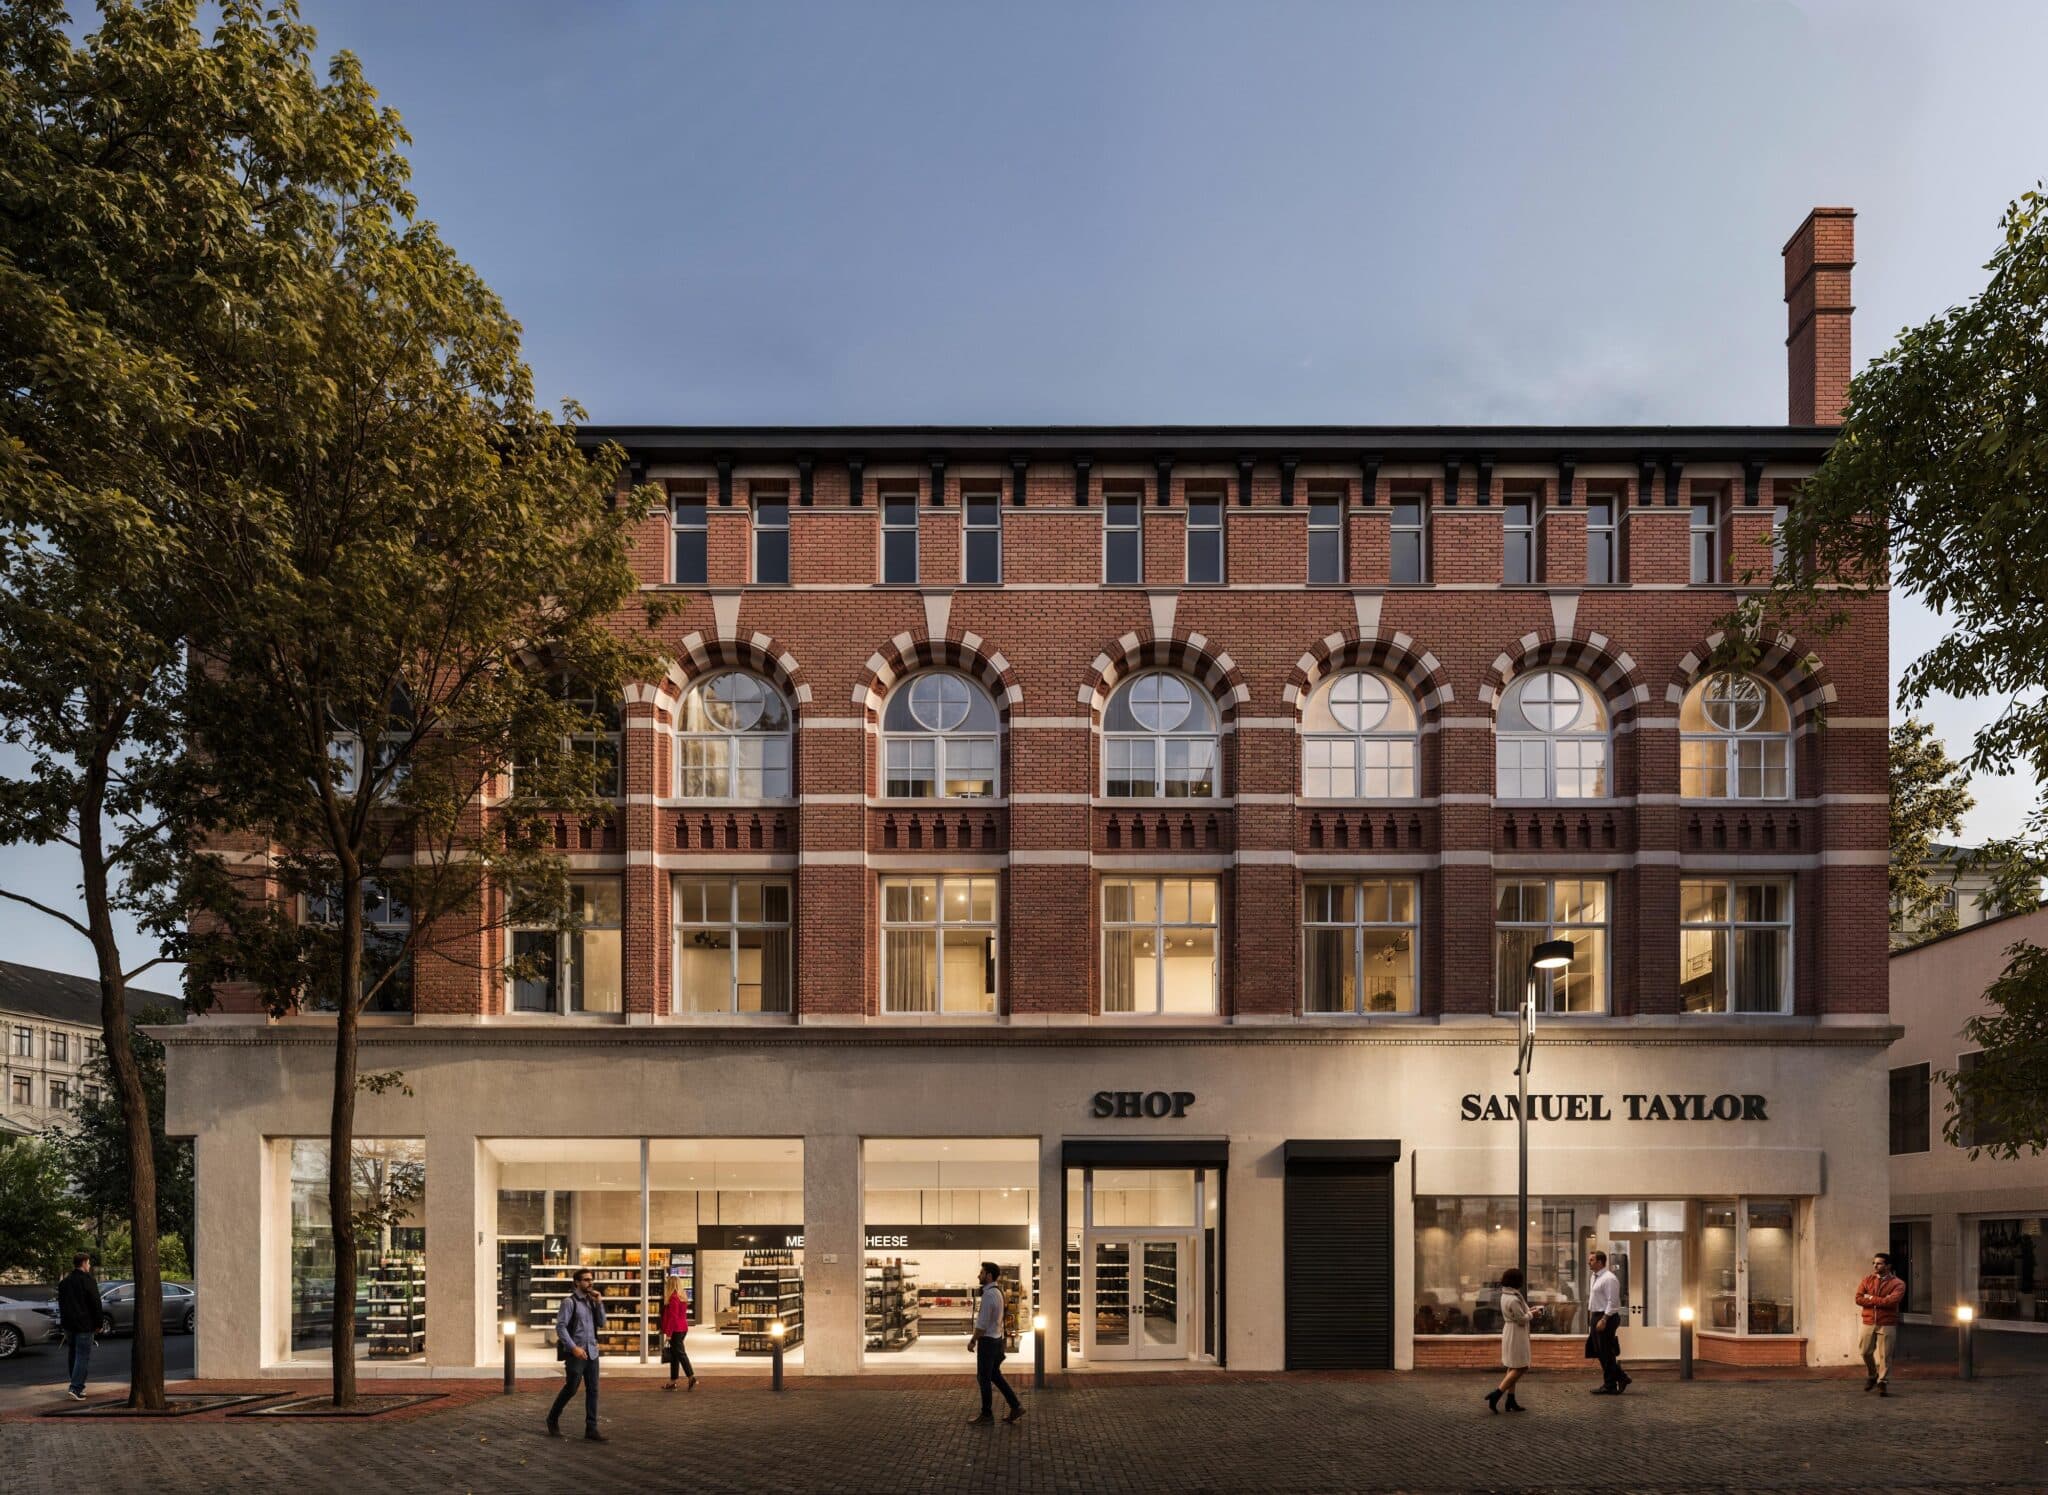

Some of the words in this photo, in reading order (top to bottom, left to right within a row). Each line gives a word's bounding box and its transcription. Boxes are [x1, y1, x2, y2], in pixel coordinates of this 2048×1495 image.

[1093, 1091, 1196, 1118] SHOP
[1461, 1094, 1612, 1122] SAMUEL
[1622, 1094, 1770, 1121] TAYLOR
[786, 1235, 805, 1247] ME
[865, 1235, 909, 1247] HEESE
